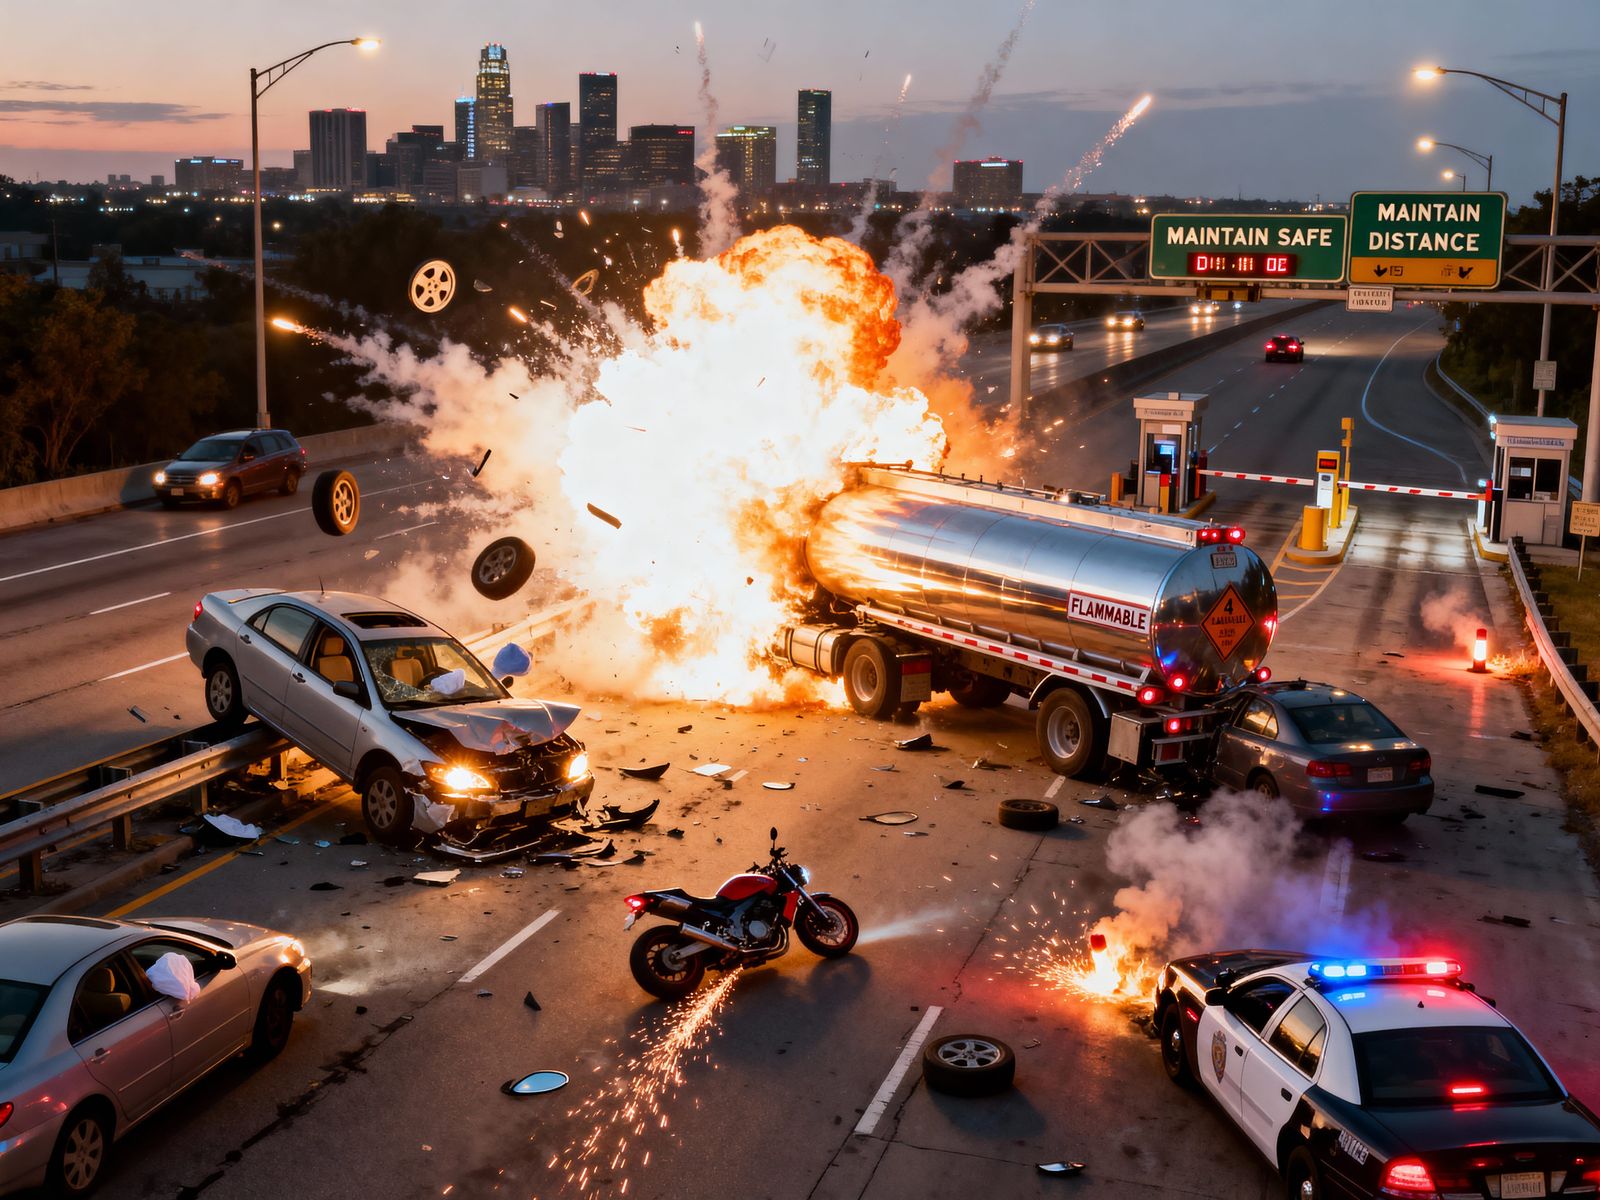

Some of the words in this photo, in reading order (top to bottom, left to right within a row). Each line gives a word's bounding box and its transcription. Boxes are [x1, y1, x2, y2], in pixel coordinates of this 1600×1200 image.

[1378, 203, 1481, 222] MAINTAIN
[1167, 226, 1269, 246] MAINTAIN
[1278, 228, 1333, 247] SAFE
[1369, 232, 1480, 252] DISTANCE
[1071, 597, 1147, 630] FLAMMABLE
[1224, 598, 1233, 615] 4
